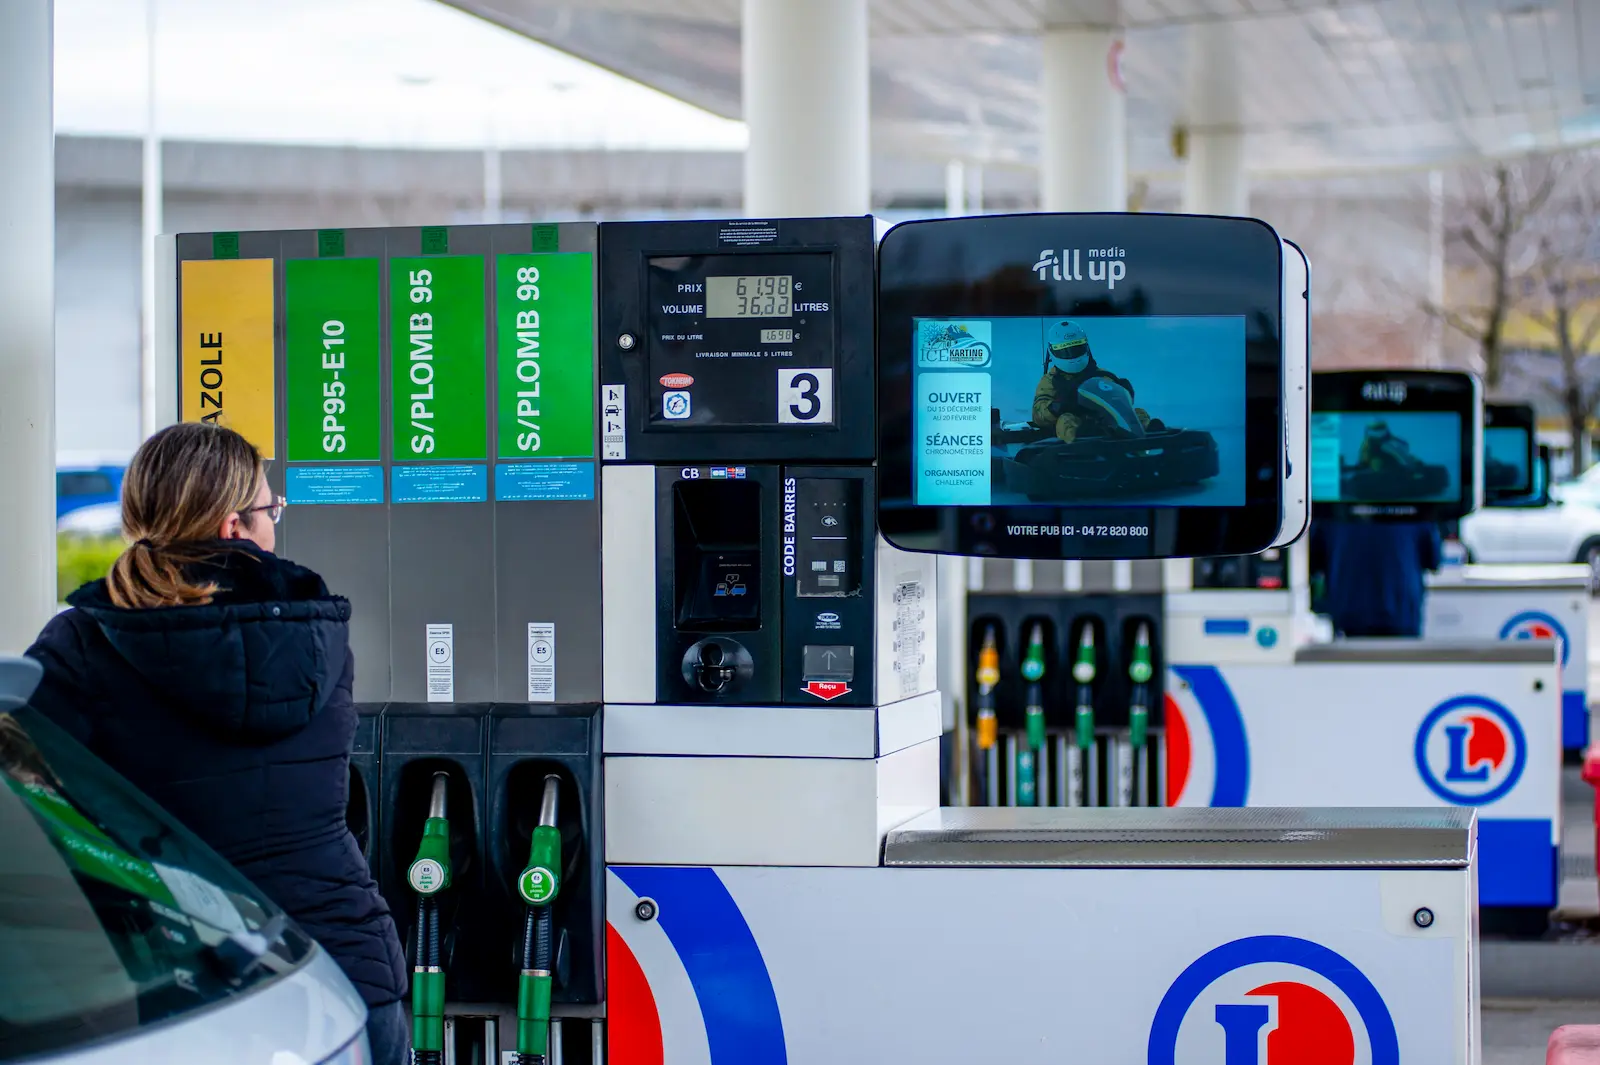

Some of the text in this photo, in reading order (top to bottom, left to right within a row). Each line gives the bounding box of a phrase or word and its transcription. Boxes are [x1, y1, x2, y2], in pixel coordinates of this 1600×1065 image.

[1088, 246, 1126, 258] media
[1032, 249, 1126, 290] fill up
[677, 284, 703, 293] PRIX
[794, 282, 803, 291] €
[662, 304, 703, 314] VOLUME
[794, 302, 829, 312] LITRES
[516, 266, 540, 452] S/PLOMB 98
[949, 349, 983, 357] KARTING
[409, 268, 434, 454] S/PLOMB 95
[200, 332, 223, 424] AZOLE
[322, 319, 346, 453] SP95-E10
[789, 372, 822, 420] 3
[928, 392, 982, 403] OUVERT
[947, 404, 983, 412] DÉCEMBRE
[951, 413, 977, 421] FÉVRIER
[926, 432, 983, 446] SÉANCES
[925, 447, 984, 455] CHRONOMÉTRÉES
[681, 467, 700, 479] CB
[924, 469, 985, 477] ORGANISATION
[784, 477, 796, 576] CODE BARRES
[1007, 525, 1039, 536] VOTRE
[1040, 525, 1060, 536] PUB
[1061, 525, 1075, 536] ICI
[1082, 525, 1095, 536] 04
[1096, 525, 1108, 536] 72
[1109, 525, 1128, 536] 820
[1129, 525, 1149, 536] 800
[435, 647, 445, 655] E5
